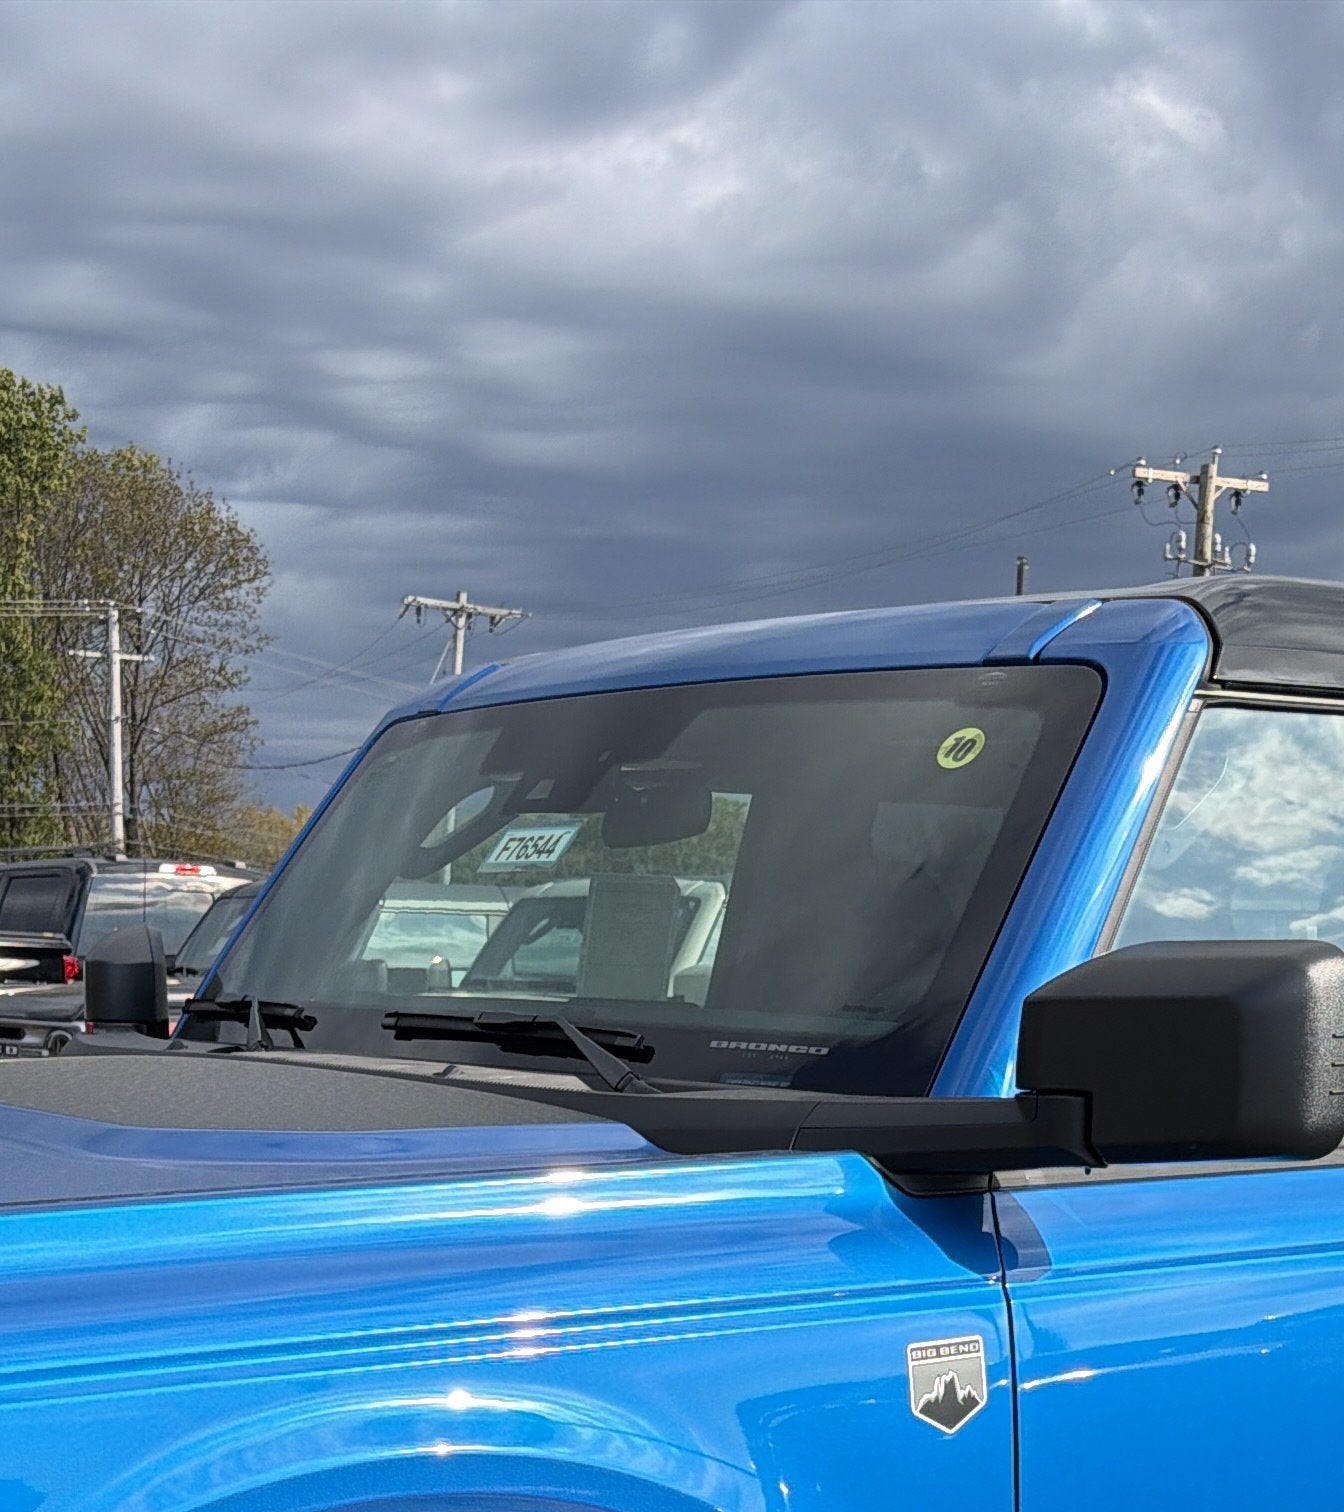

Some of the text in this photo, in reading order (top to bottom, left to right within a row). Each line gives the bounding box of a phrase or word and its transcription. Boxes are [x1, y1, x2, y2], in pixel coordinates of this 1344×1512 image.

[944, 735, 977, 762] 10
[495, 834, 564, 862] F76544
[709, 1040, 832, 1056] BRONCO
[911, 1342, 980, 1360] BIG BEND
